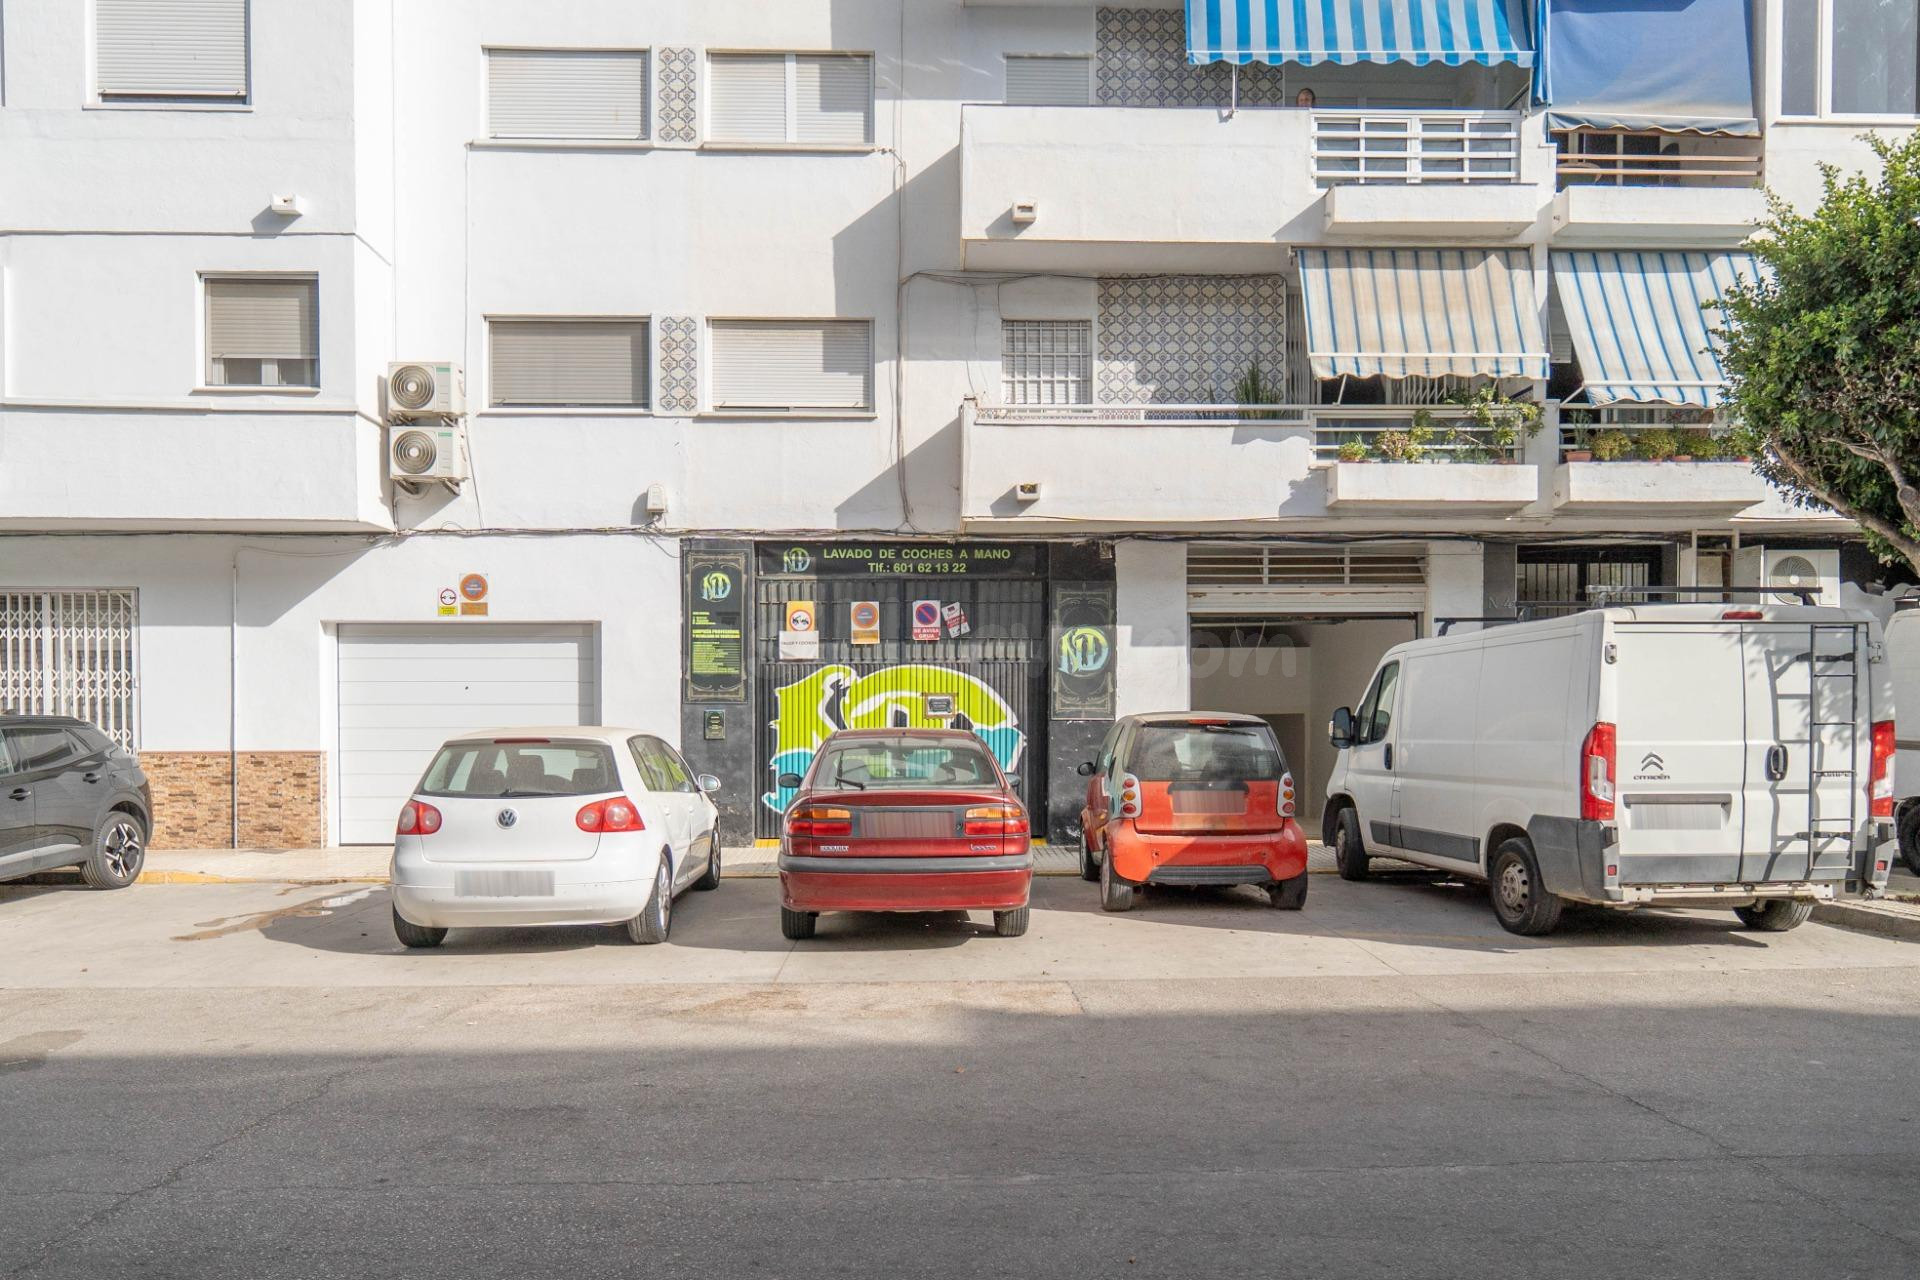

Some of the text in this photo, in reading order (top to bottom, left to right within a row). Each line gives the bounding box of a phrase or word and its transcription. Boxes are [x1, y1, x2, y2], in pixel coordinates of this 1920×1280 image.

[823, 549, 1011, 560] LAVADO DE COCHES A MANO
[893, 562, 914, 573] 601
[917, 562, 932, 573] 62
[935, 562, 950, 573] 13
[952, 562, 967, 573] 22
